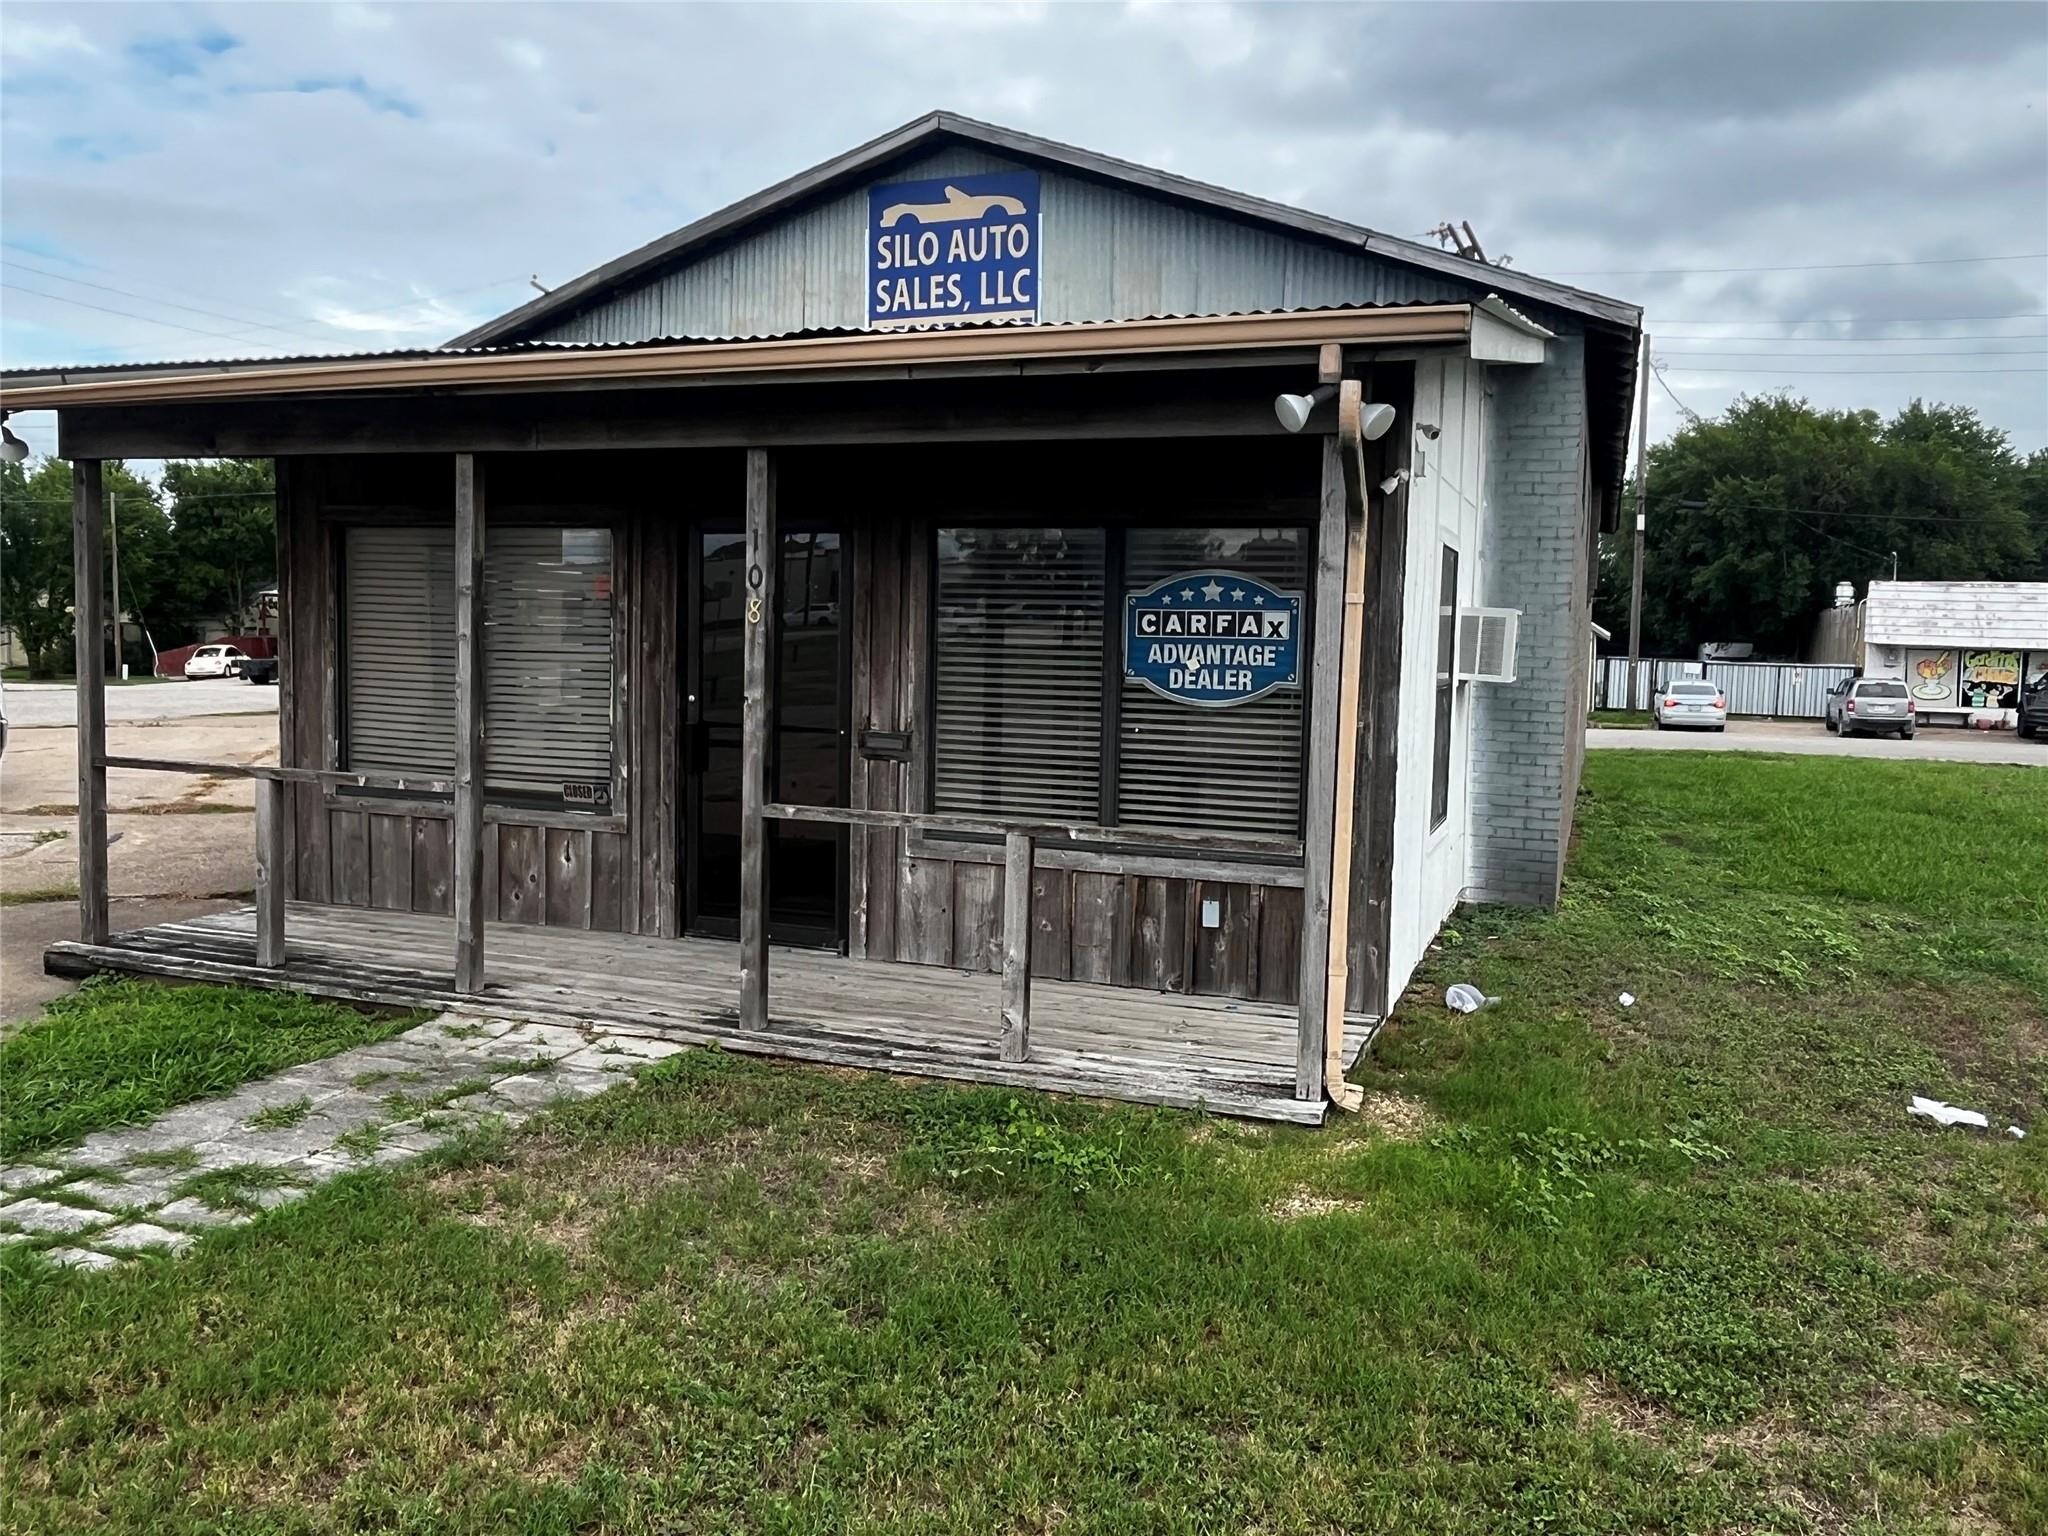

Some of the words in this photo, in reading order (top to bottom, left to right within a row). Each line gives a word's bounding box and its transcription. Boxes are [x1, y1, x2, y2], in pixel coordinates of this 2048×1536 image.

[877, 231, 939, 270] SILO
[947, 223, 1029, 264] AUTO
[876, 273, 970, 313] SALES,
[980, 268, 1031, 306] LLC
[1141, 614, 1284, 639] CARFAX
[1148, 643, 1276, 667] ADVANTAGE
[1169, 668, 1252, 691] DEALER
[563, 784, 593, 799] CLOSED
